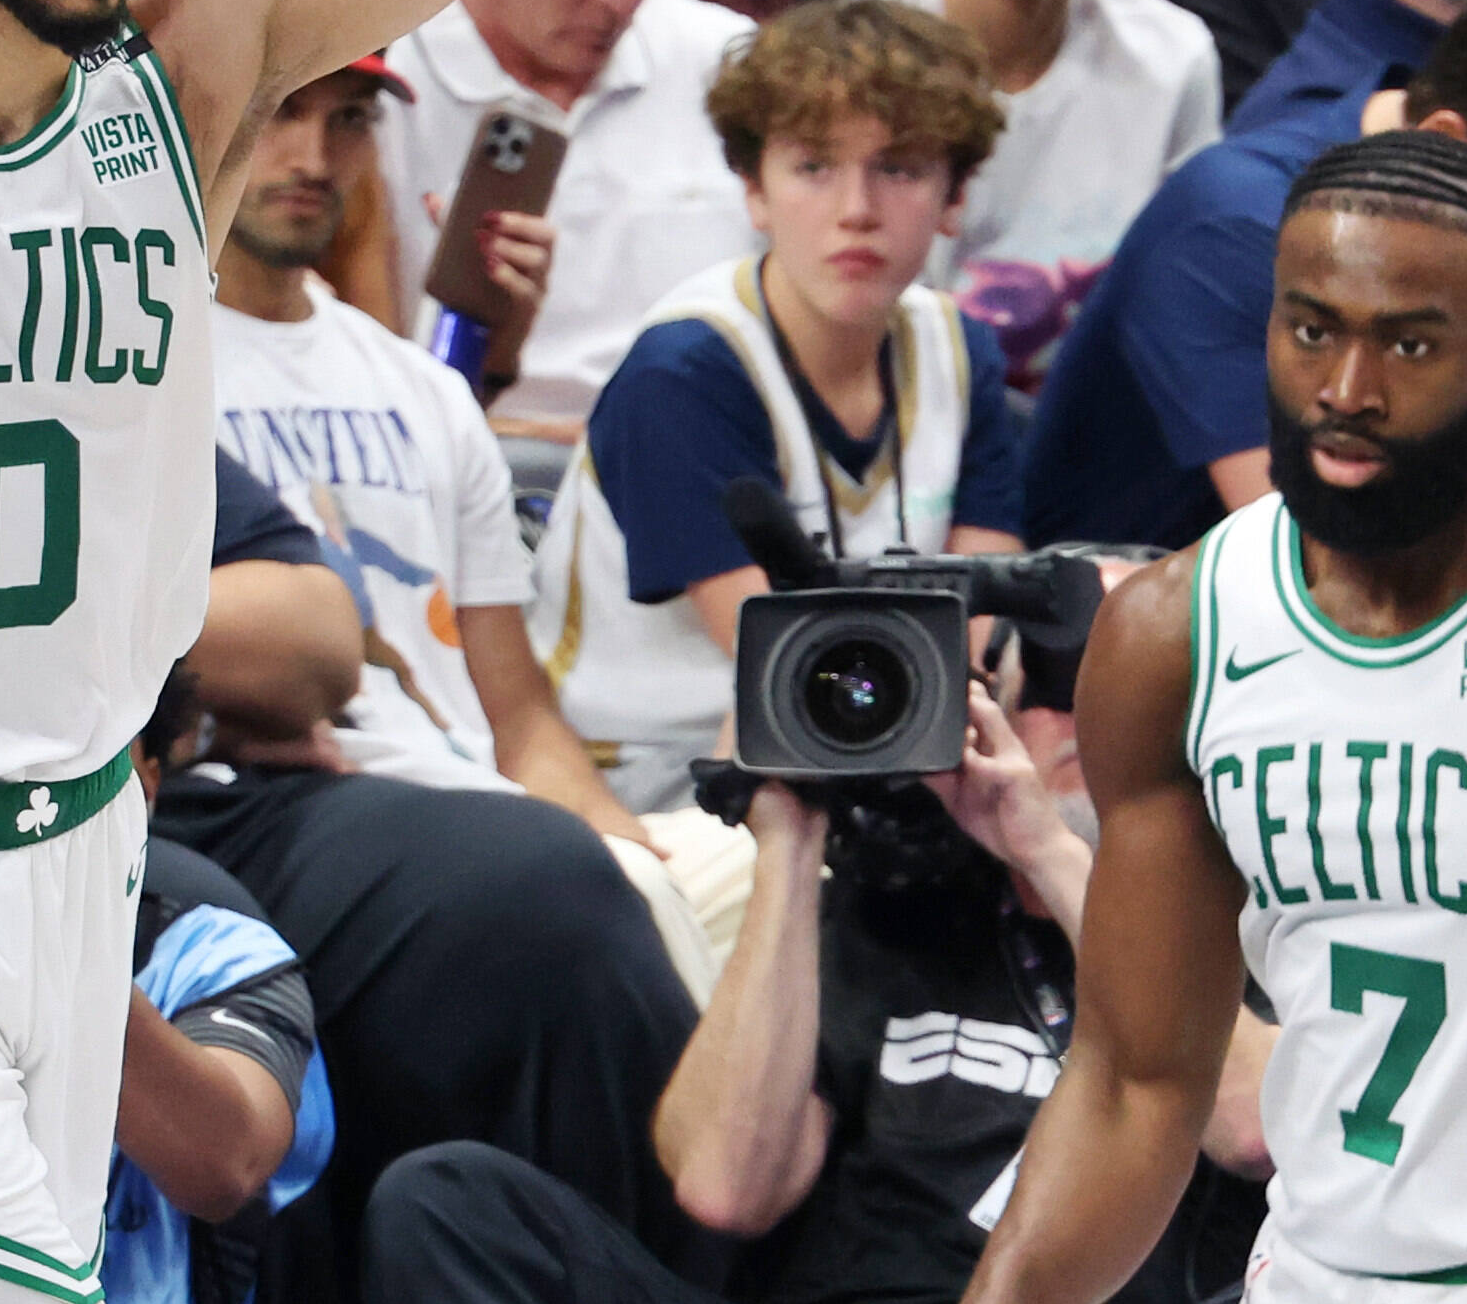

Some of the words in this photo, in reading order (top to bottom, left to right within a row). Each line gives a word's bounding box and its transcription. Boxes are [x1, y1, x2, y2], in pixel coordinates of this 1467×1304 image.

[81, 112, 154, 158] VISTA
[93, 146, 158, 185] PRINT
[1328, 942, 1447, 1167] 7
